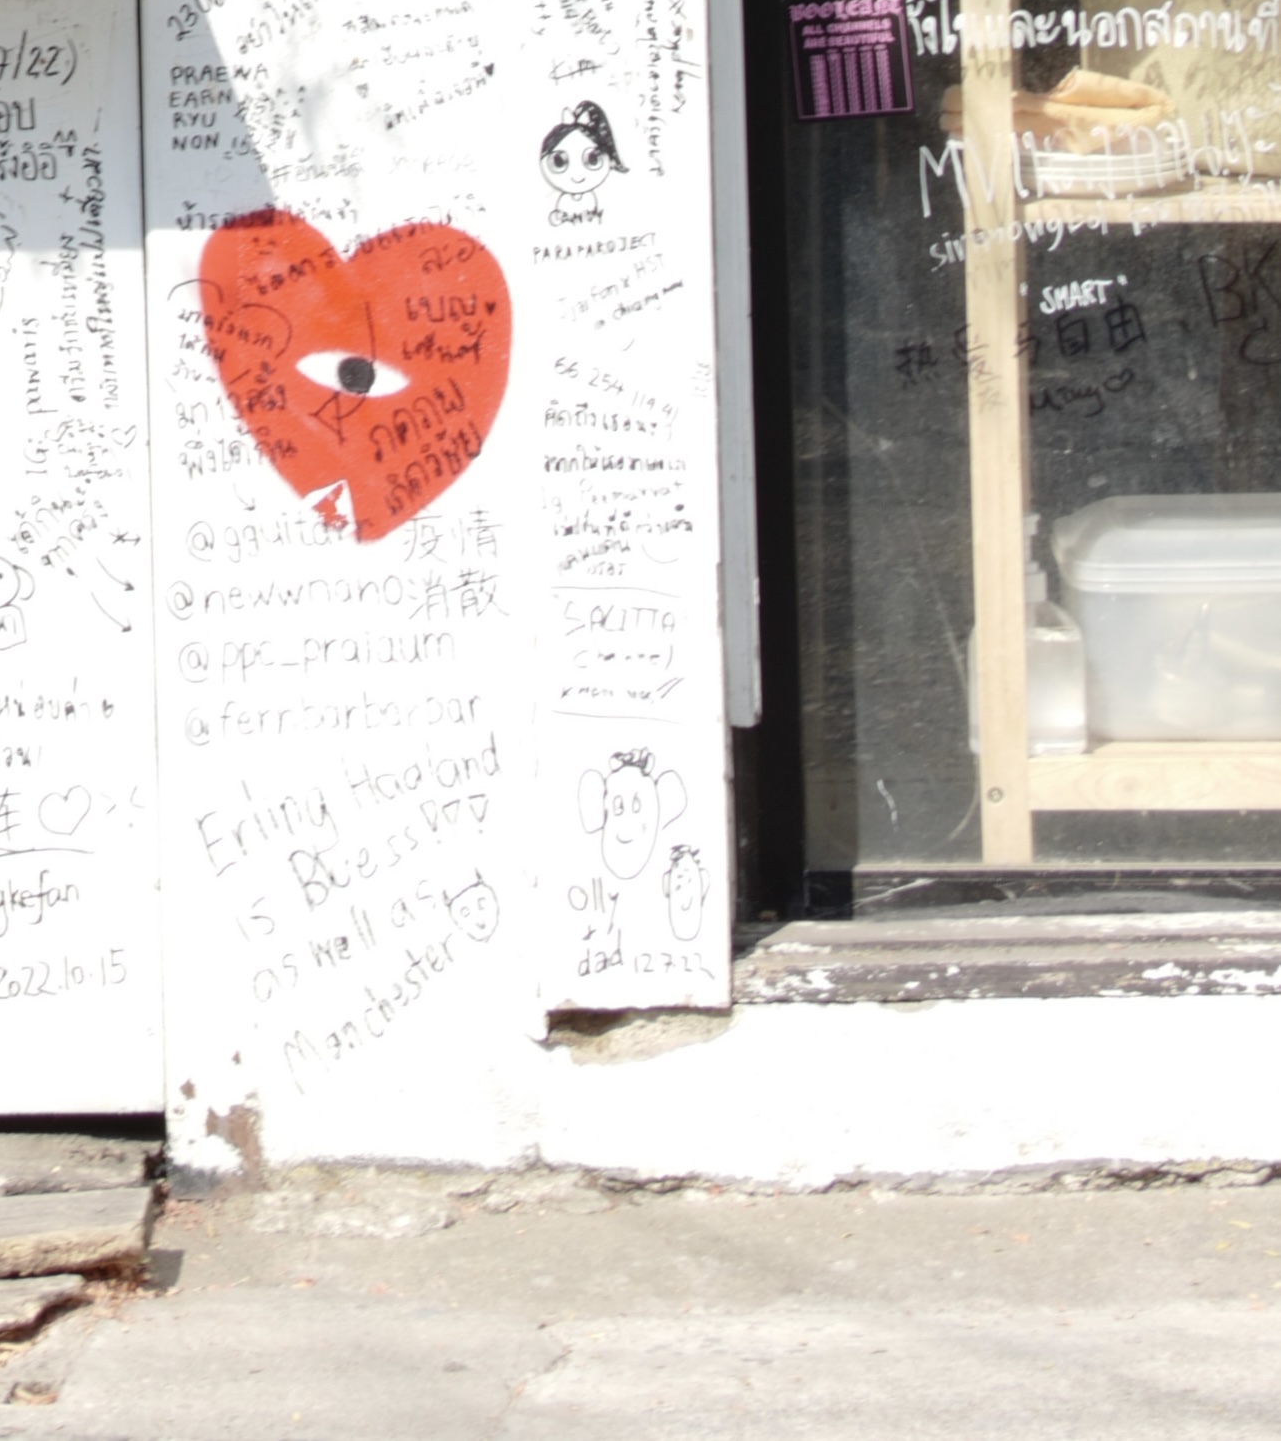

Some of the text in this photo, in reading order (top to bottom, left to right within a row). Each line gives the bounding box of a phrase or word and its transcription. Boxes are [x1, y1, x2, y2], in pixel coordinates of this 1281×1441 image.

[802, 24, 829, 37] ALL
[168, 89, 232, 108] EARN
[172, 112, 217, 129] RYU
[172, 134, 220, 151] NON
[576, 927, 625, 977] dad
